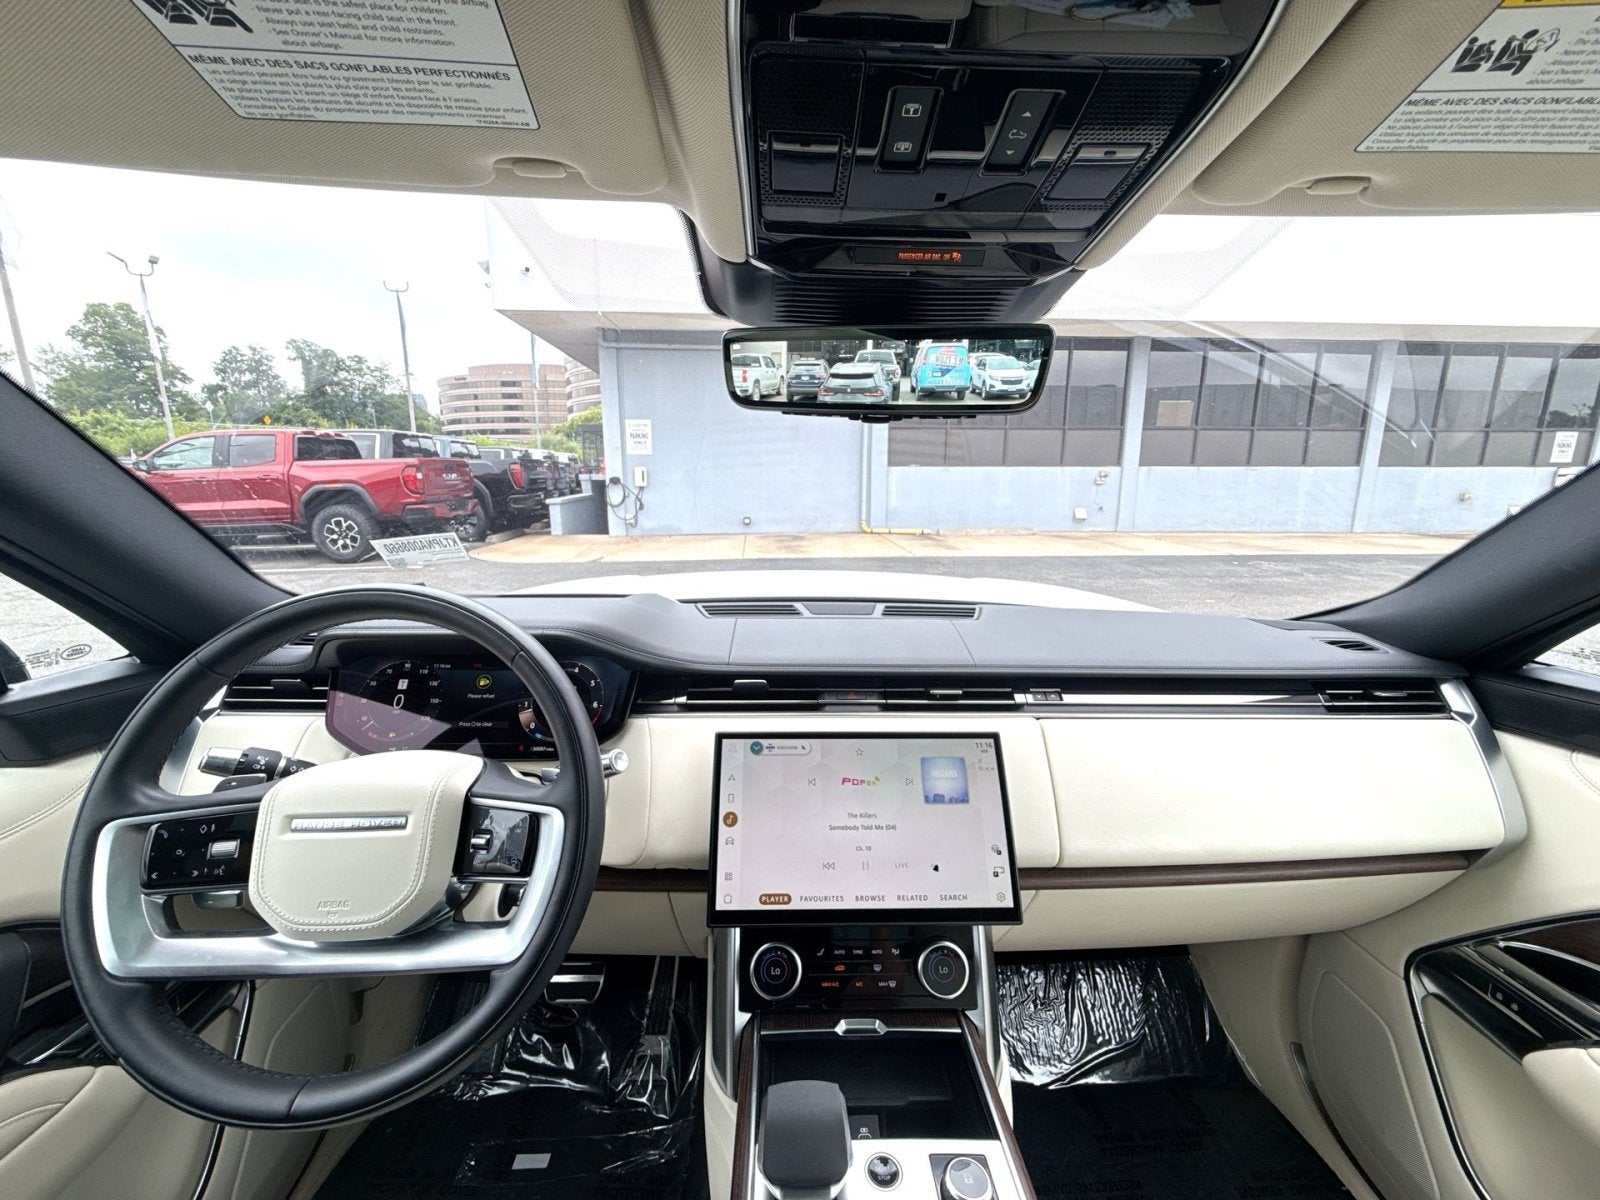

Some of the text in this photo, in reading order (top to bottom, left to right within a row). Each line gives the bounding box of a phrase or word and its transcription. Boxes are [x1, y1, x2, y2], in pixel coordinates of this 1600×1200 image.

[186, 52, 510, 80] MÊME AVEC DES SACS GONFLABLES PERFECTIONNÉS
[1404, 98, 1441, 106] MÊME
[1442, 98, 1476, 106] AVEC
[1500, 97, 1535, 105] SACS
[394, 694, 405, 709] 0
[317, 900, 350, 910] AIRBAG
[771, 967, 780, 975] Lo
[939, 966, 949, 974] Lo
